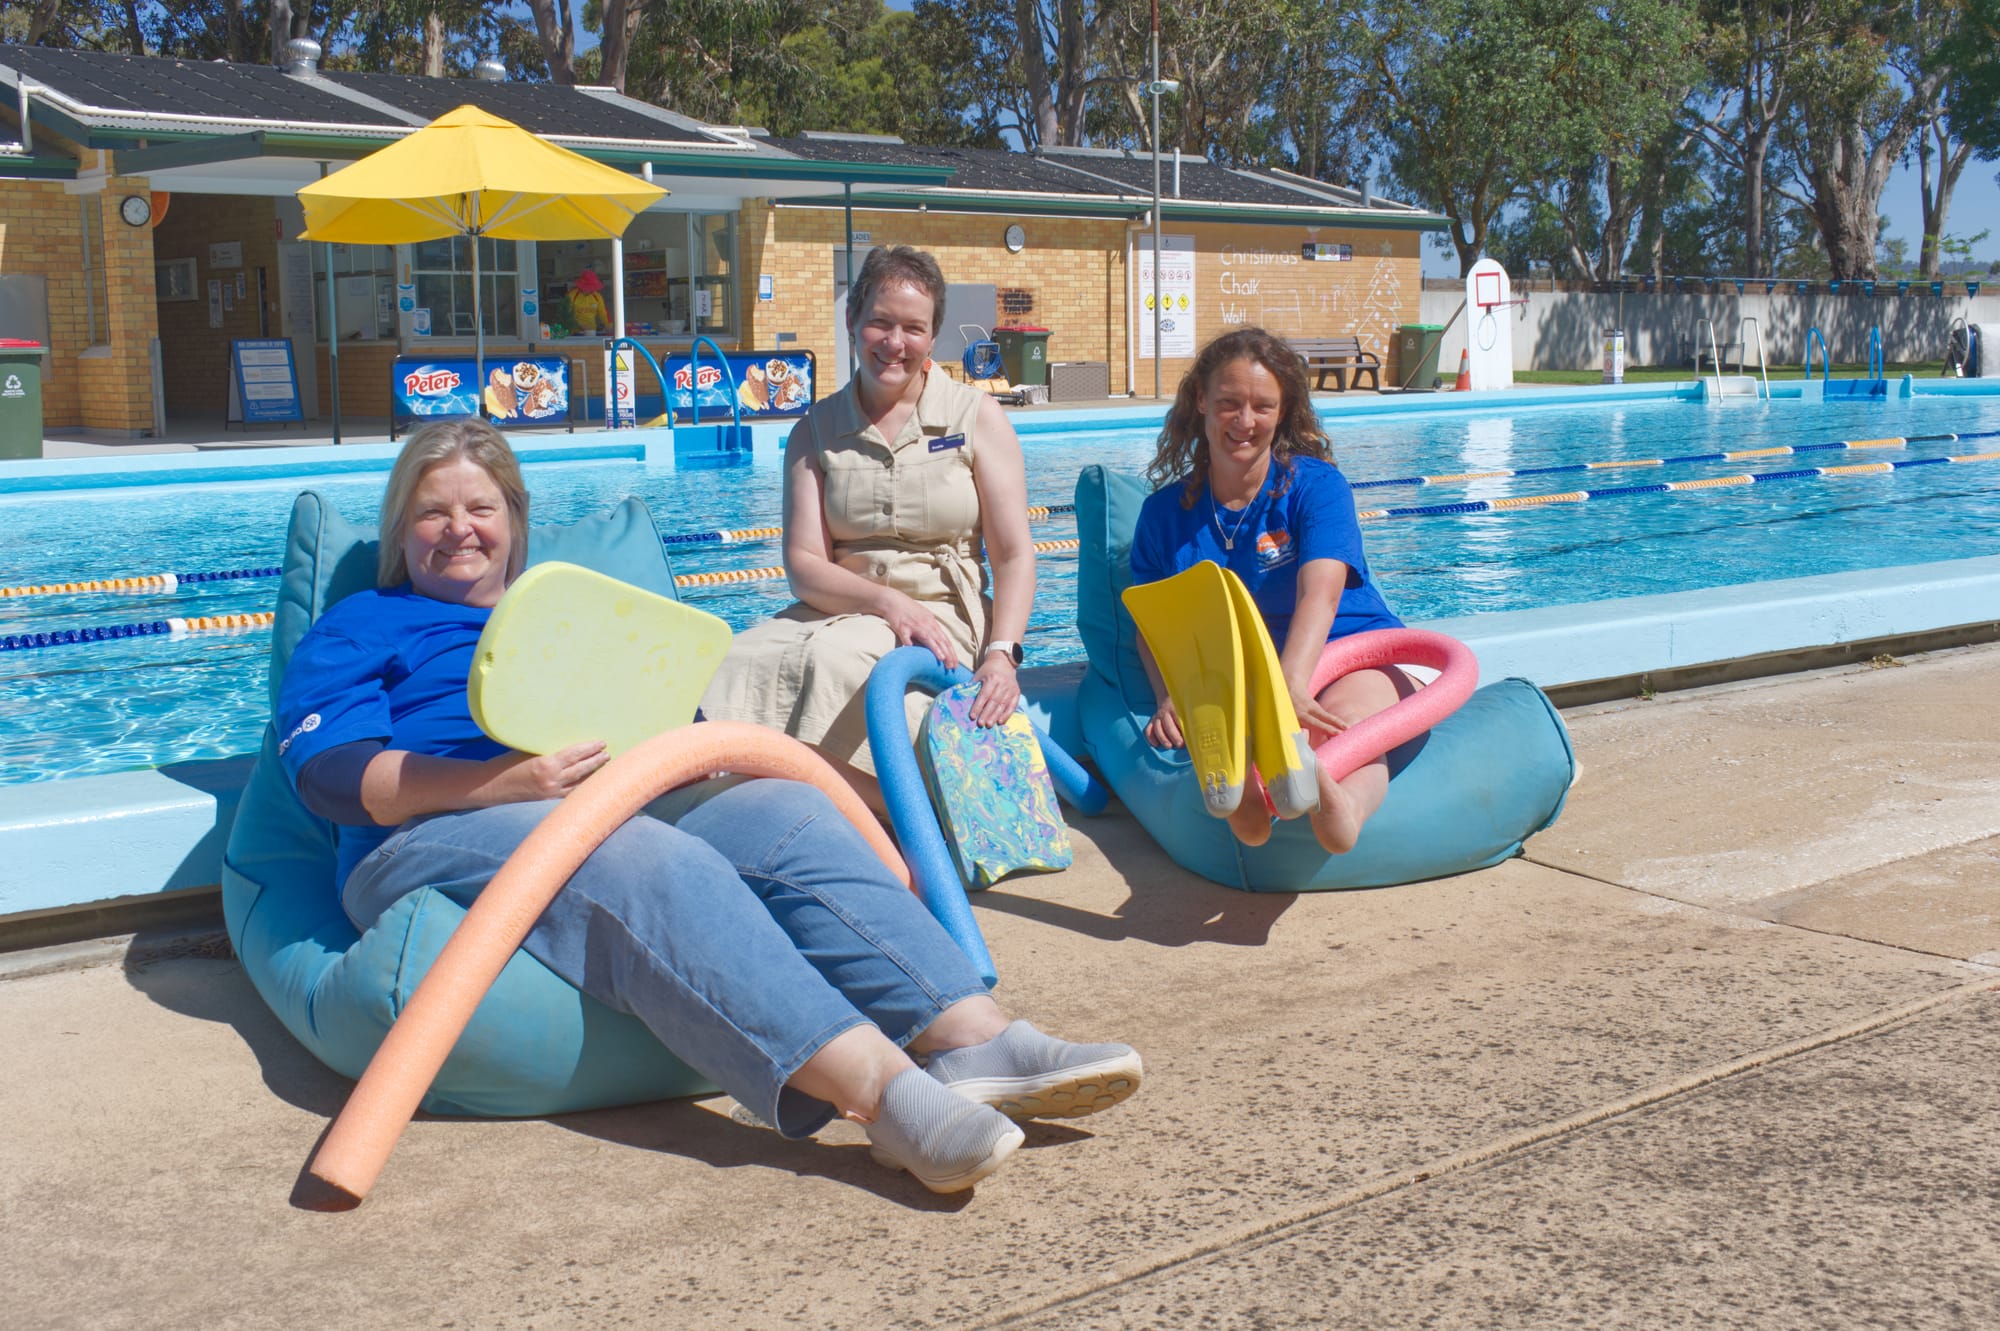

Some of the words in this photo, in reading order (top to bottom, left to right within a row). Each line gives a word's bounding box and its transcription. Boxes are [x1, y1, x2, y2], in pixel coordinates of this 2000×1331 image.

[852, 232, 870, 241] LADIES
[1219, 244, 1298, 266] Christmas
[1219, 271, 1261, 295] Chalk
[1220, 301, 1247, 324] Wall
[405, 371, 460, 396] Peters
[675, 367, 721, 390] Peers
